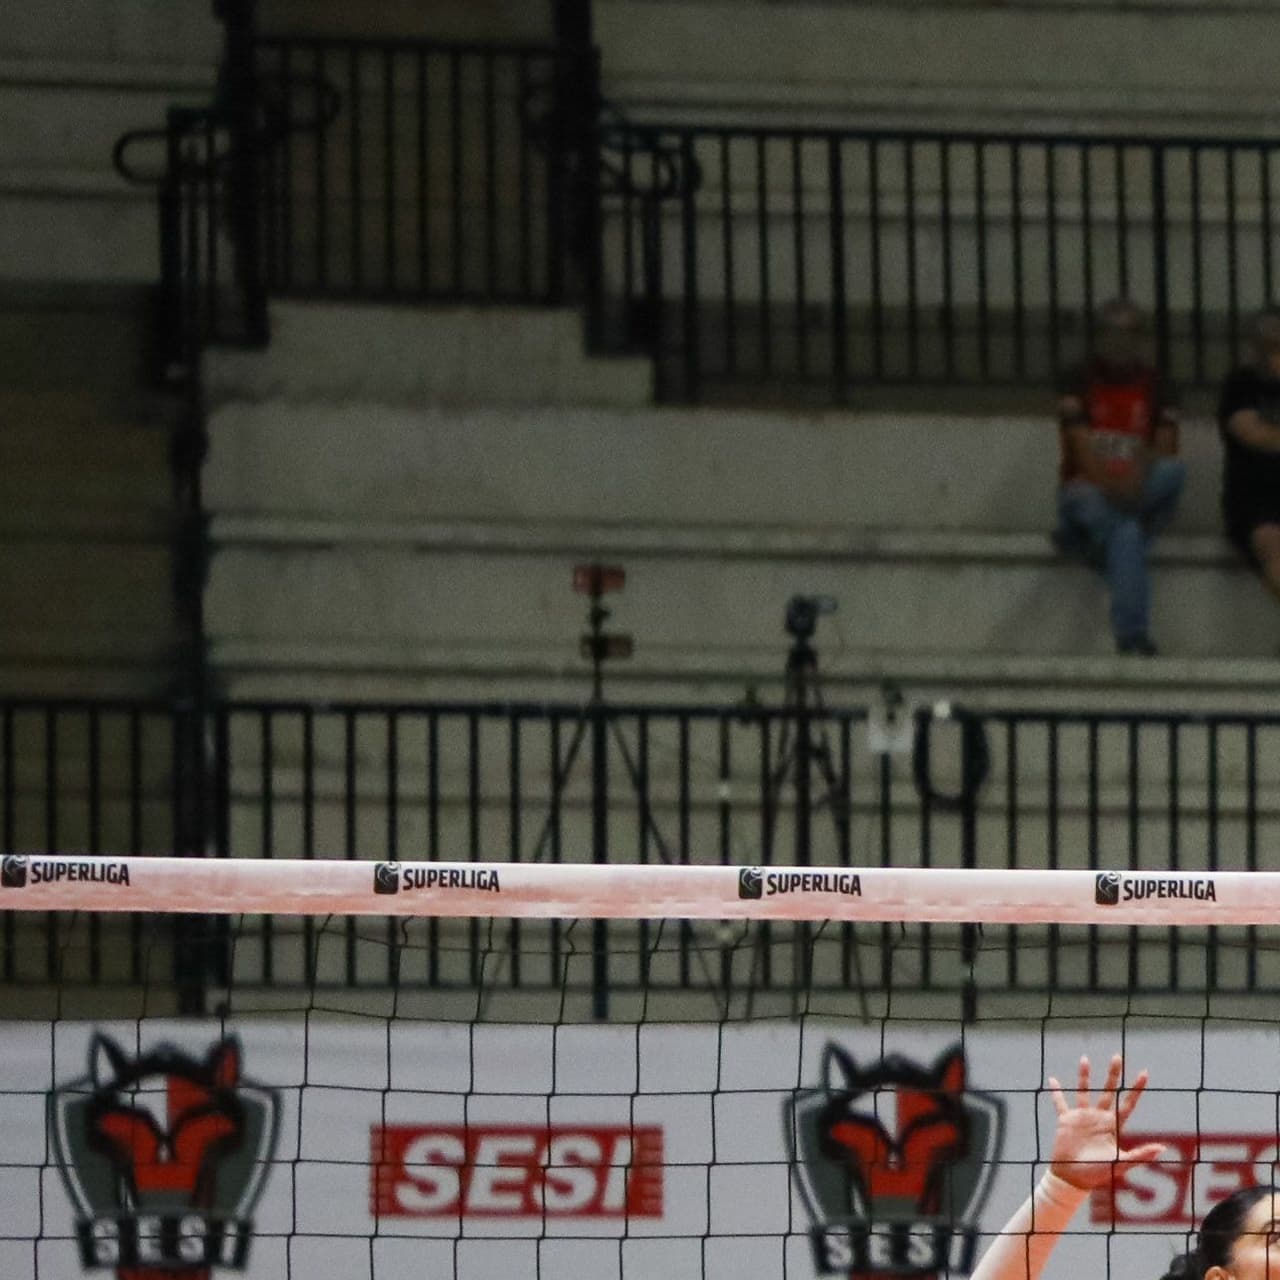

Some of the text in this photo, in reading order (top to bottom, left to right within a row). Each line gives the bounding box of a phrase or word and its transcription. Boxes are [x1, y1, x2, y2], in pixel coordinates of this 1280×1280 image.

[30, 861, 131, 886] SUPERLIGA
[402, 867, 501, 893] SUPERLIGA
[766, 872, 862, 898] SUPERLIGA
[1123, 878, 1217, 903] SUPERLIGA
[395, 1135, 633, 1211] SESI
[93, 1216, 239, 1263] SESI
[825, 1223, 965, 1269] SESI
